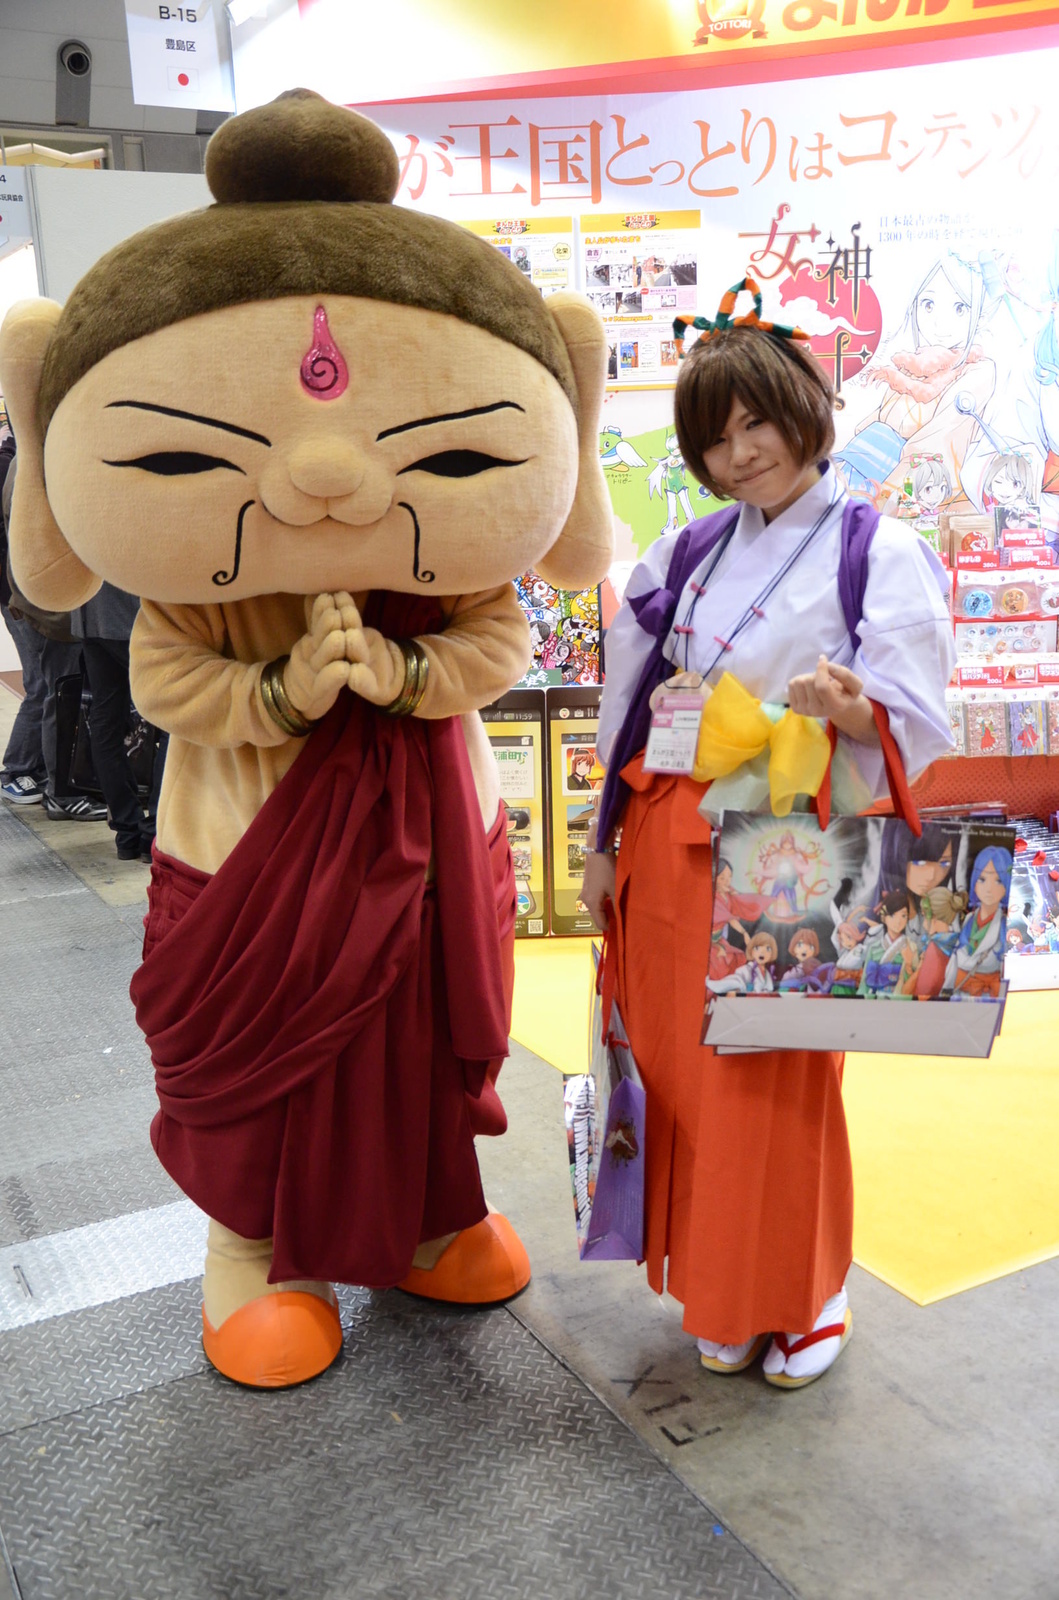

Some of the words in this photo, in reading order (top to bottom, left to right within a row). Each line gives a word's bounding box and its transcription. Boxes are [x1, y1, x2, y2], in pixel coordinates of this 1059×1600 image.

[159, 6, 197, 22] B-15
[708, 19, 752, 33] TOTTORI
[165, 38, 196, 51] 豊島区
[556, 247, 569, 255] 北栄
[587, 249, 600, 257] 倉吉
